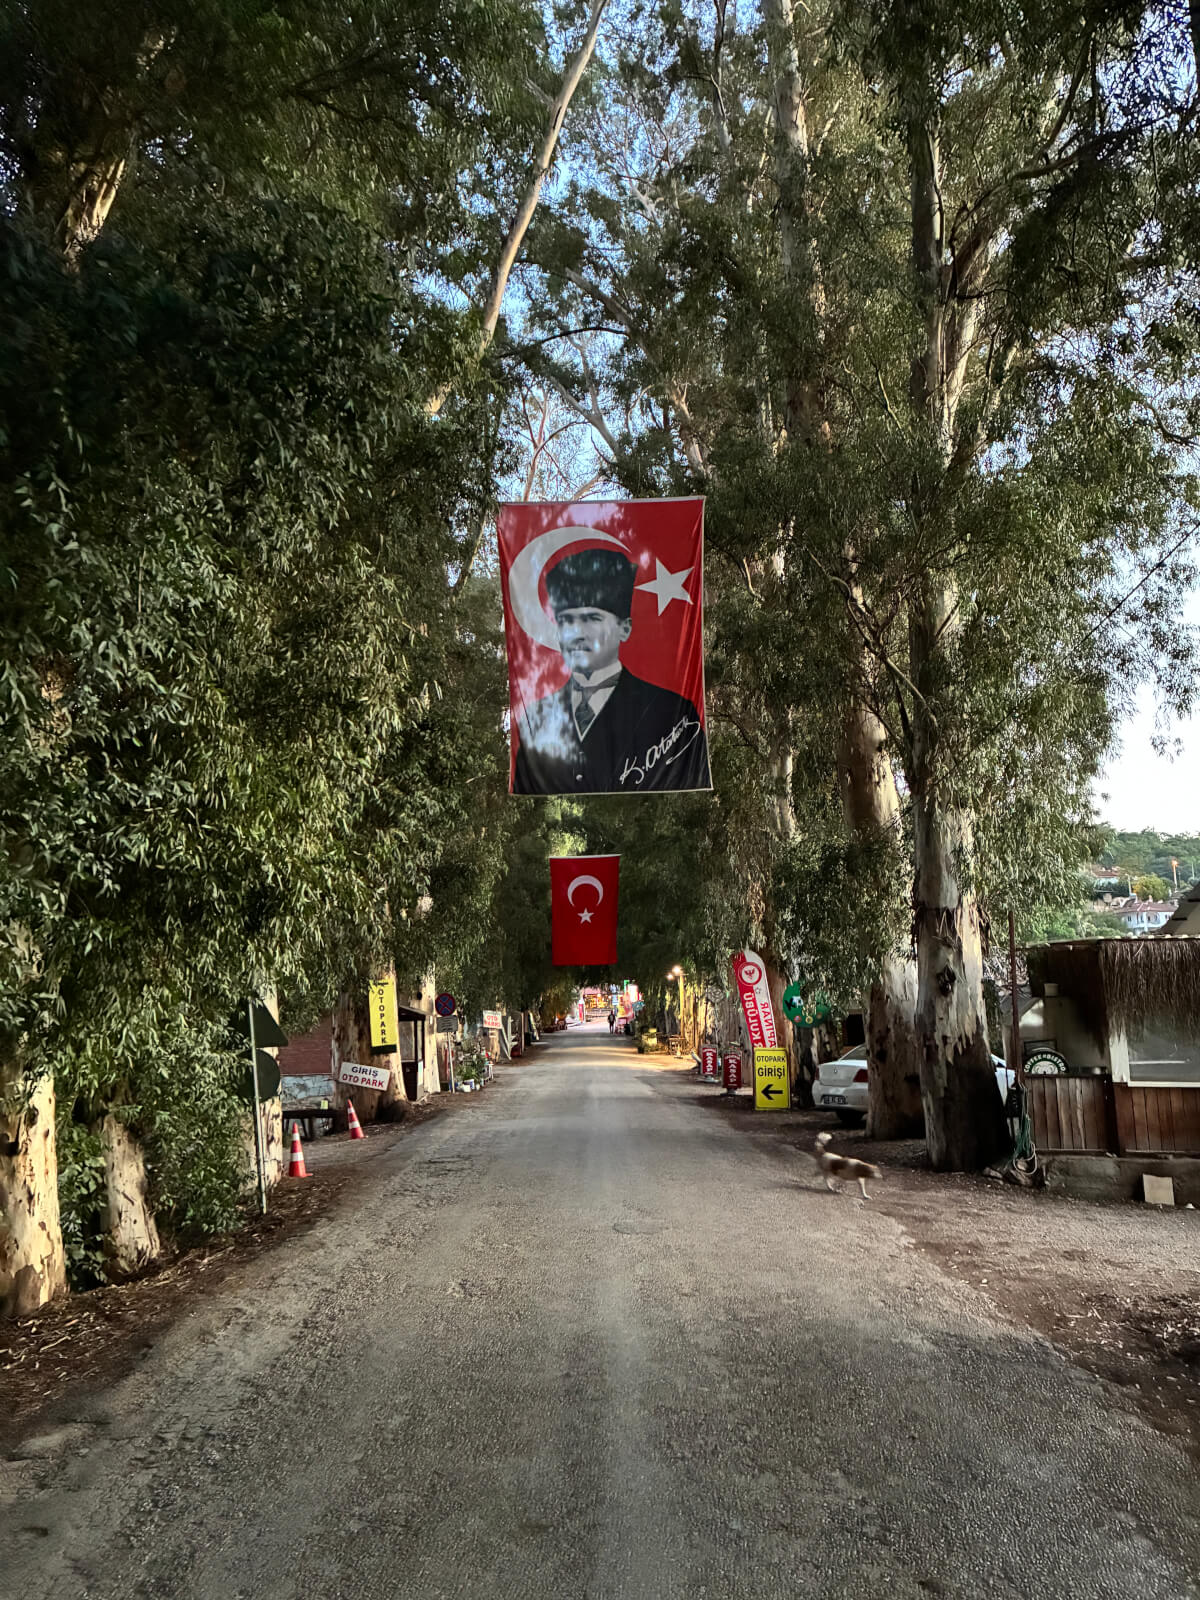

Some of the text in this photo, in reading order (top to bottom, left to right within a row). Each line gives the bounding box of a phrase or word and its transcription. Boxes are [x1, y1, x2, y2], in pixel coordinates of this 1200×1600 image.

[377, 988, 386, 1044] OTOPARK
[756, 1055, 786, 1063] OTOPARK
[1023, 1054, 1042, 1073] COFFEE
[757, 1065, 786, 1079] GİRİŞİ
[342, 1073, 385, 1088] OTO PARK
